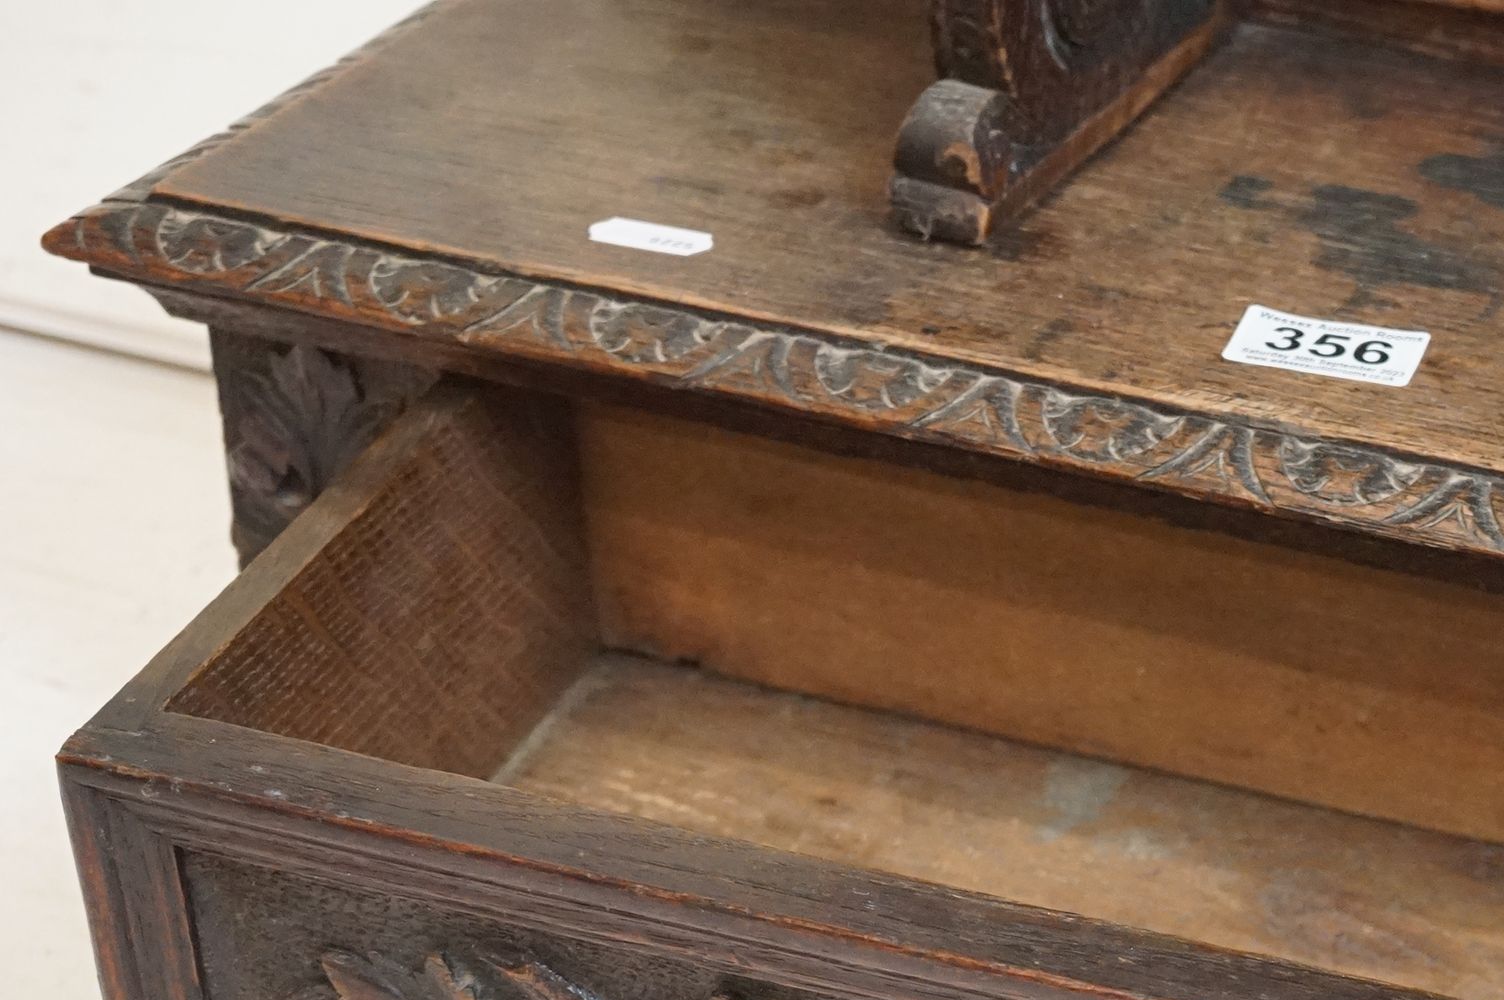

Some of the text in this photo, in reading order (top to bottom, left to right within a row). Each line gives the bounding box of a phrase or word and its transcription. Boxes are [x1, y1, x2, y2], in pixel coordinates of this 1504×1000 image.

[1260, 311, 1424, 342] Wessex Auction Rooms
[1264, 327, 1394, 365] 356
